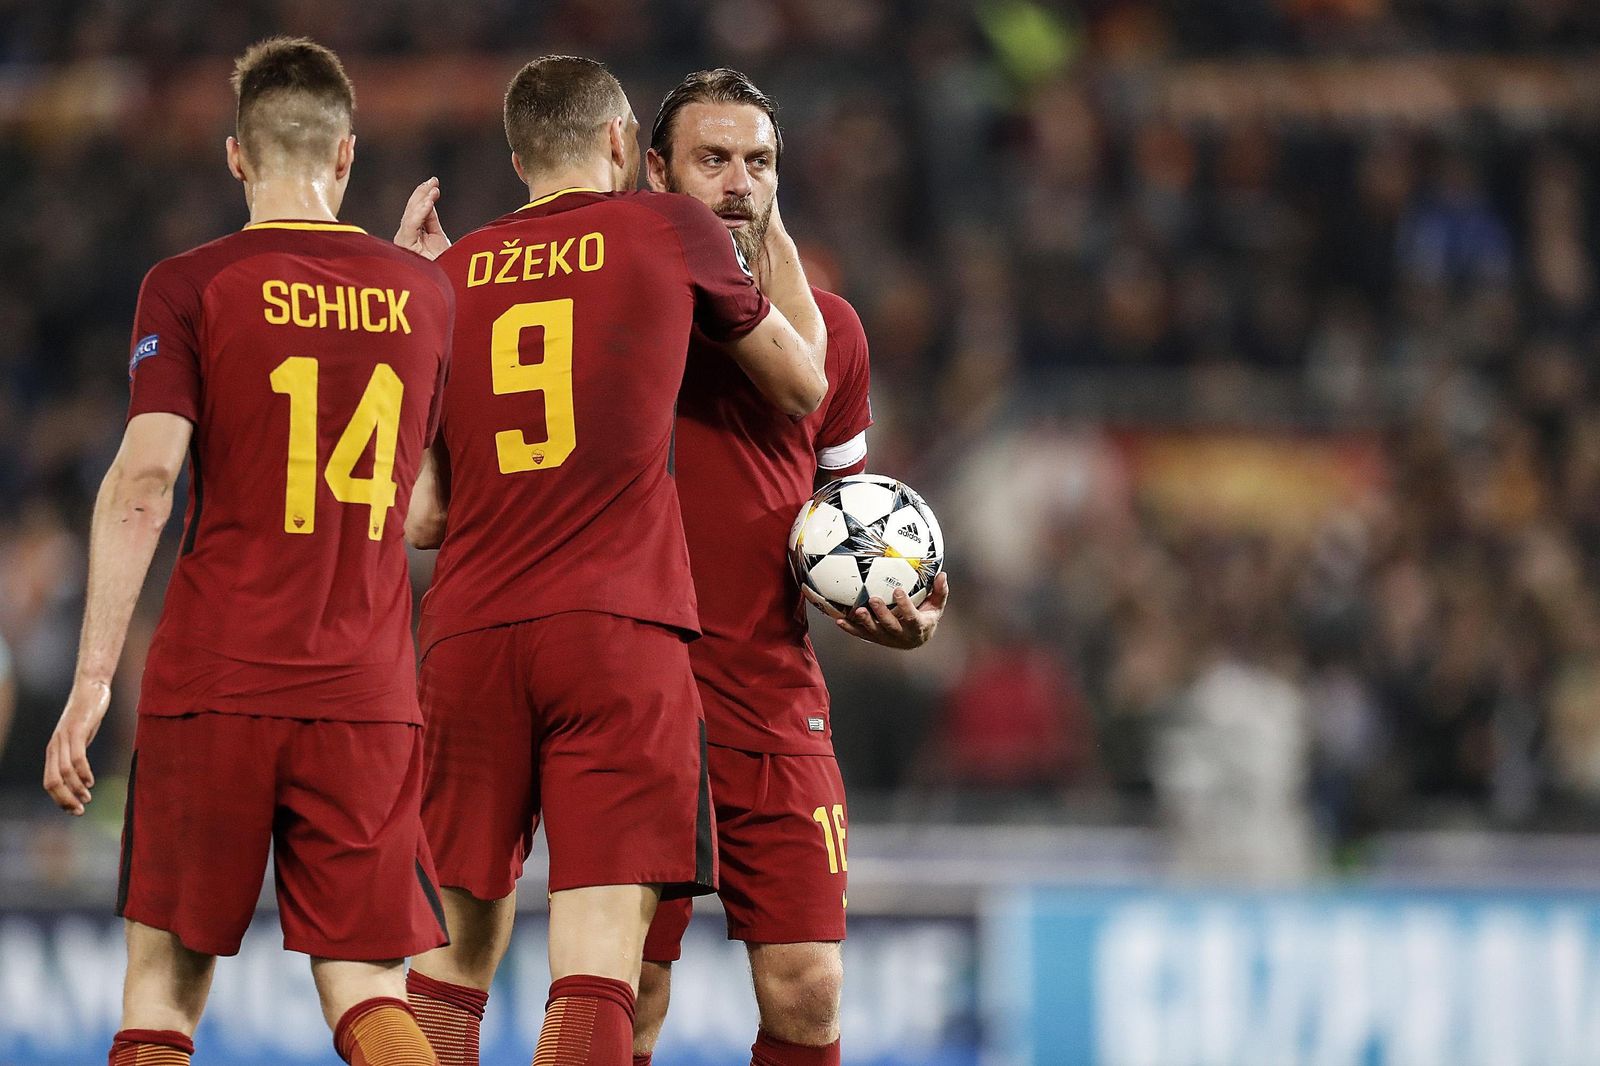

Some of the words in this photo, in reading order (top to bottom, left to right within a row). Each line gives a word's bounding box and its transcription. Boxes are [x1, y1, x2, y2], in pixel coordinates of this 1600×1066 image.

[467, 232, 605, 288] DŽEKO
[263, 280, 411, 334] SCHICK
[491, 298, 576, 474] 9
[270, 356, 404, 541] 14
[897, 529, 922, 544] adidas
